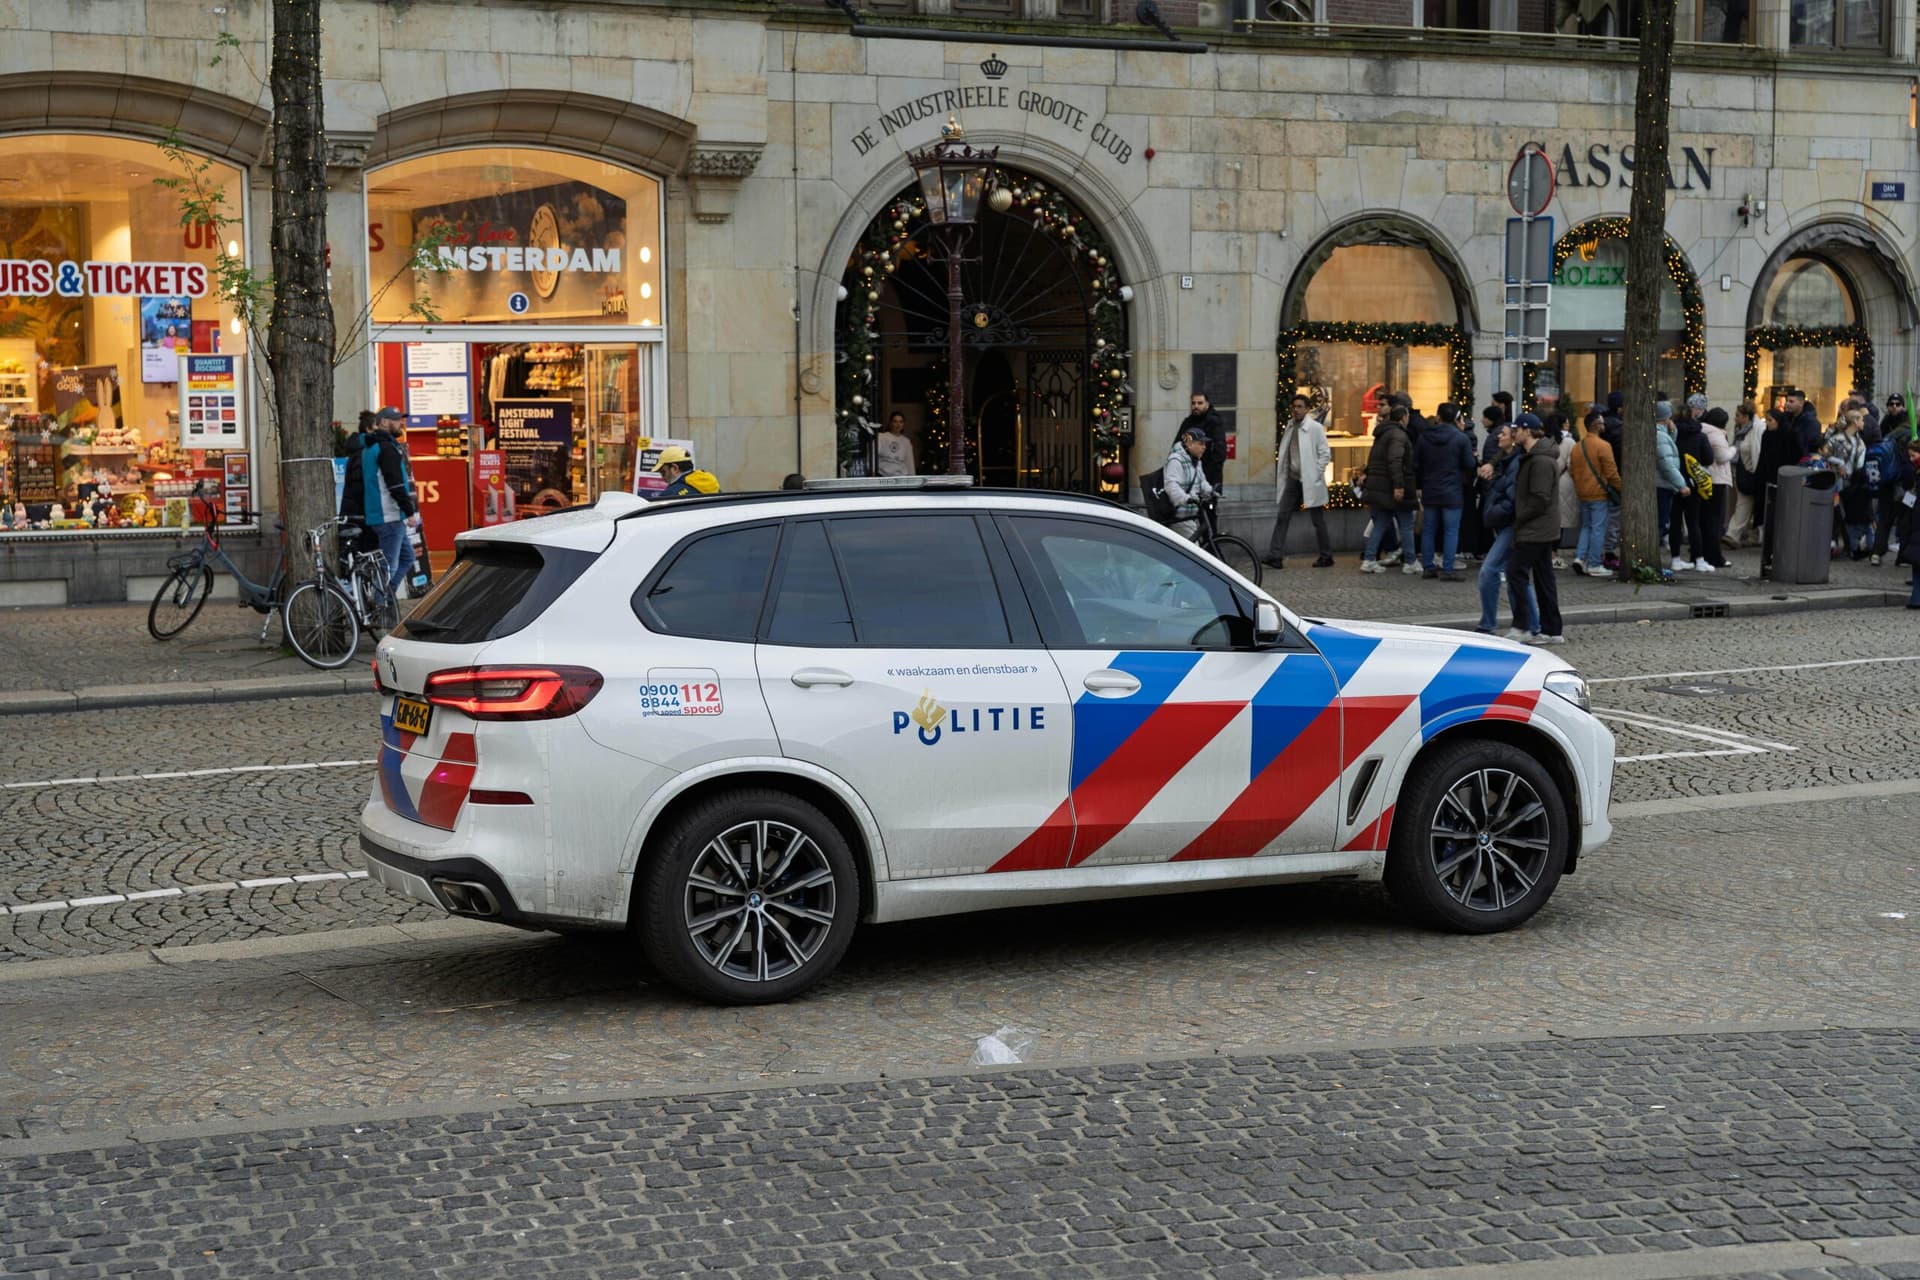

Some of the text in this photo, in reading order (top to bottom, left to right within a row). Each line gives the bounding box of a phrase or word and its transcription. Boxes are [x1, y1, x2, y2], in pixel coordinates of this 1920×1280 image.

[852, 86, 1133, 165] DE INDUSTRIEELE GROOTE CLUB
[1518, 141, 1717, 191] ASSN
[1883, 183, 1895, 193] DAM
[59, 264, 82, 293] &
[87, 264, 205, 295] TICKETS
[1553, 265, 1626, 286] ROLEX
[499, 408, 554, 419] AMSTERDAM
[499, 418, 525, 429] LIGHT
[499, 428, 540, 439] FESTIVAL
[896, 665, 954, 677] waakzaam
[956, 666, 971, 675] en
[971, 663, 1028, 675] dienstbaar
[639, 684, 678, 696] 0900
[680, 683, 720, 703] 112
[641, 697, 680, 708] 8844
[683, 703, 721, 716] spoed
[893, 706, 1045, 746] POLITIE
